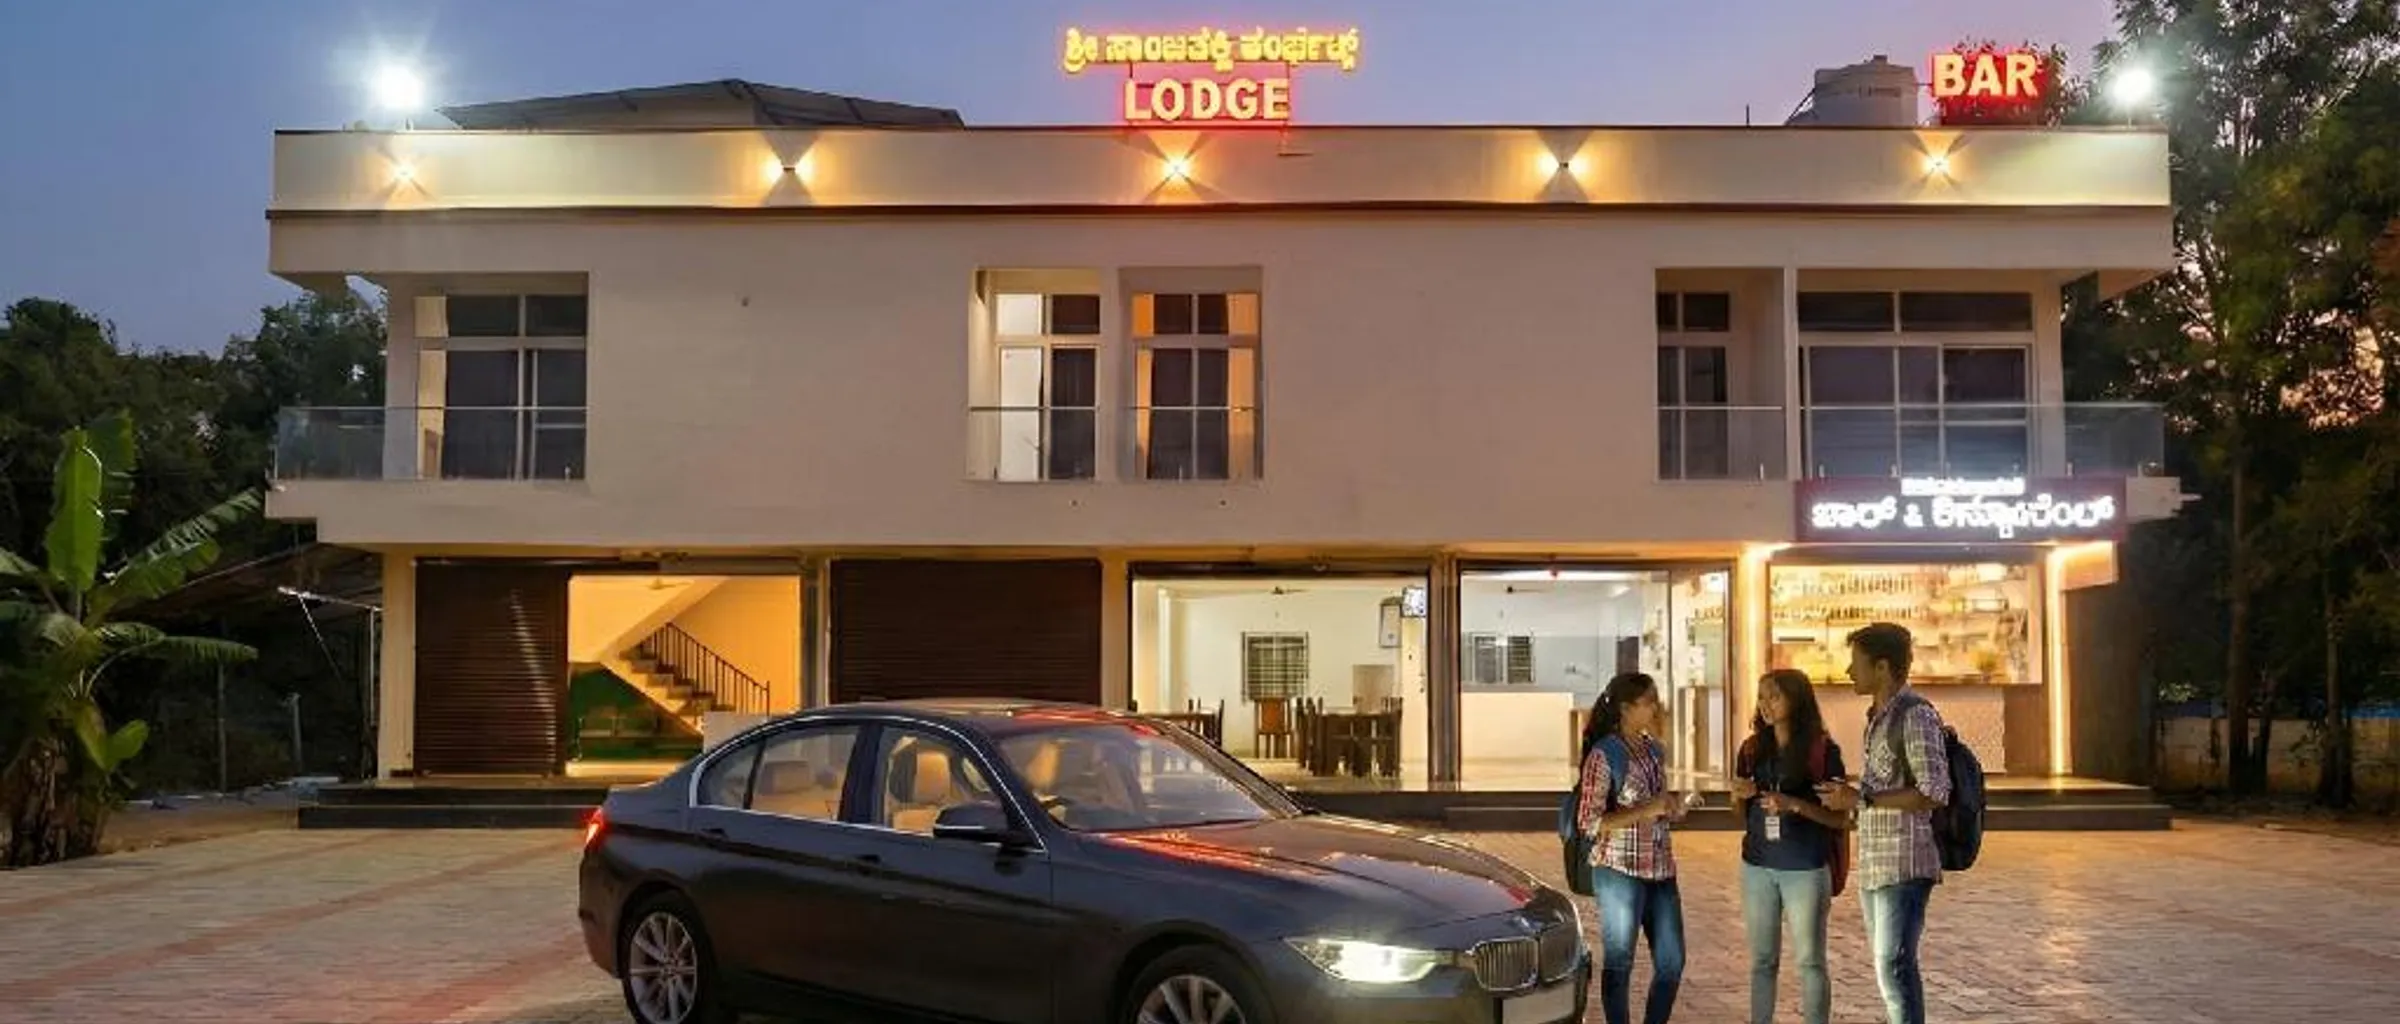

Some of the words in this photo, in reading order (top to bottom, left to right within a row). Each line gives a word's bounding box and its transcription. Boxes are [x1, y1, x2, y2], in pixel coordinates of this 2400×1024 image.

[1064, 27, 1098, 72] ಶ್ರೀ
[1933, 54, 2040, 97] BAR
[1124, 78, 1290, 121] LODGE
[1902, 502, 1924, 528] &
